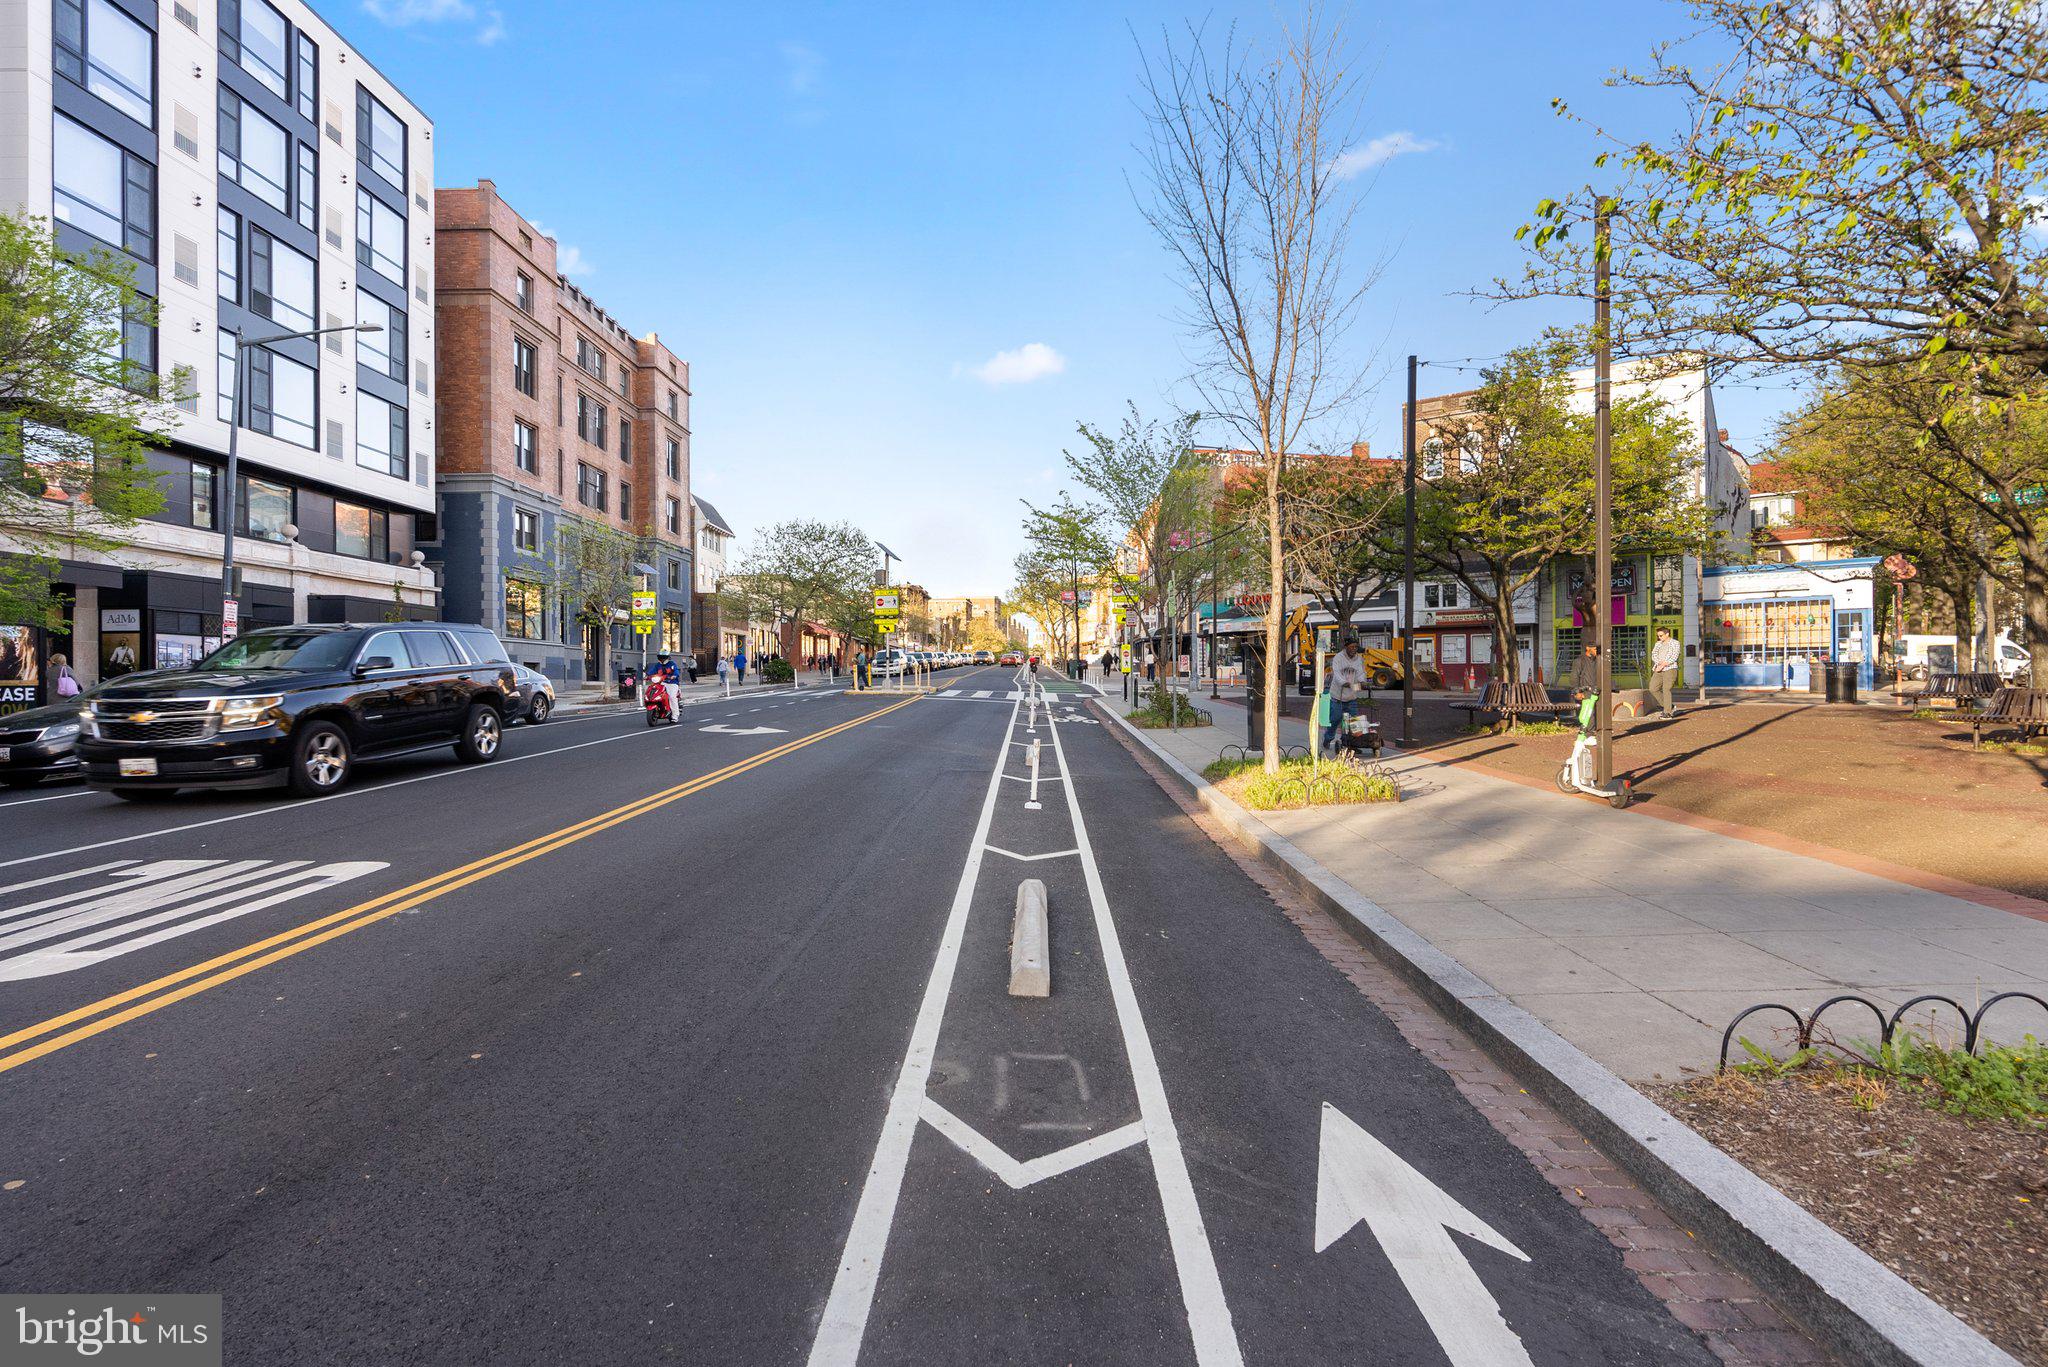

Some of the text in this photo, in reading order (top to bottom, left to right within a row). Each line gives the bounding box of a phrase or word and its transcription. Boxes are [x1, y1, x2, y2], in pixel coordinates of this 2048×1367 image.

[1611, 577, 1632, 587] PEN
[106, 614, 136, 624] AdMo
[0, 687, 35, 702] ASE
